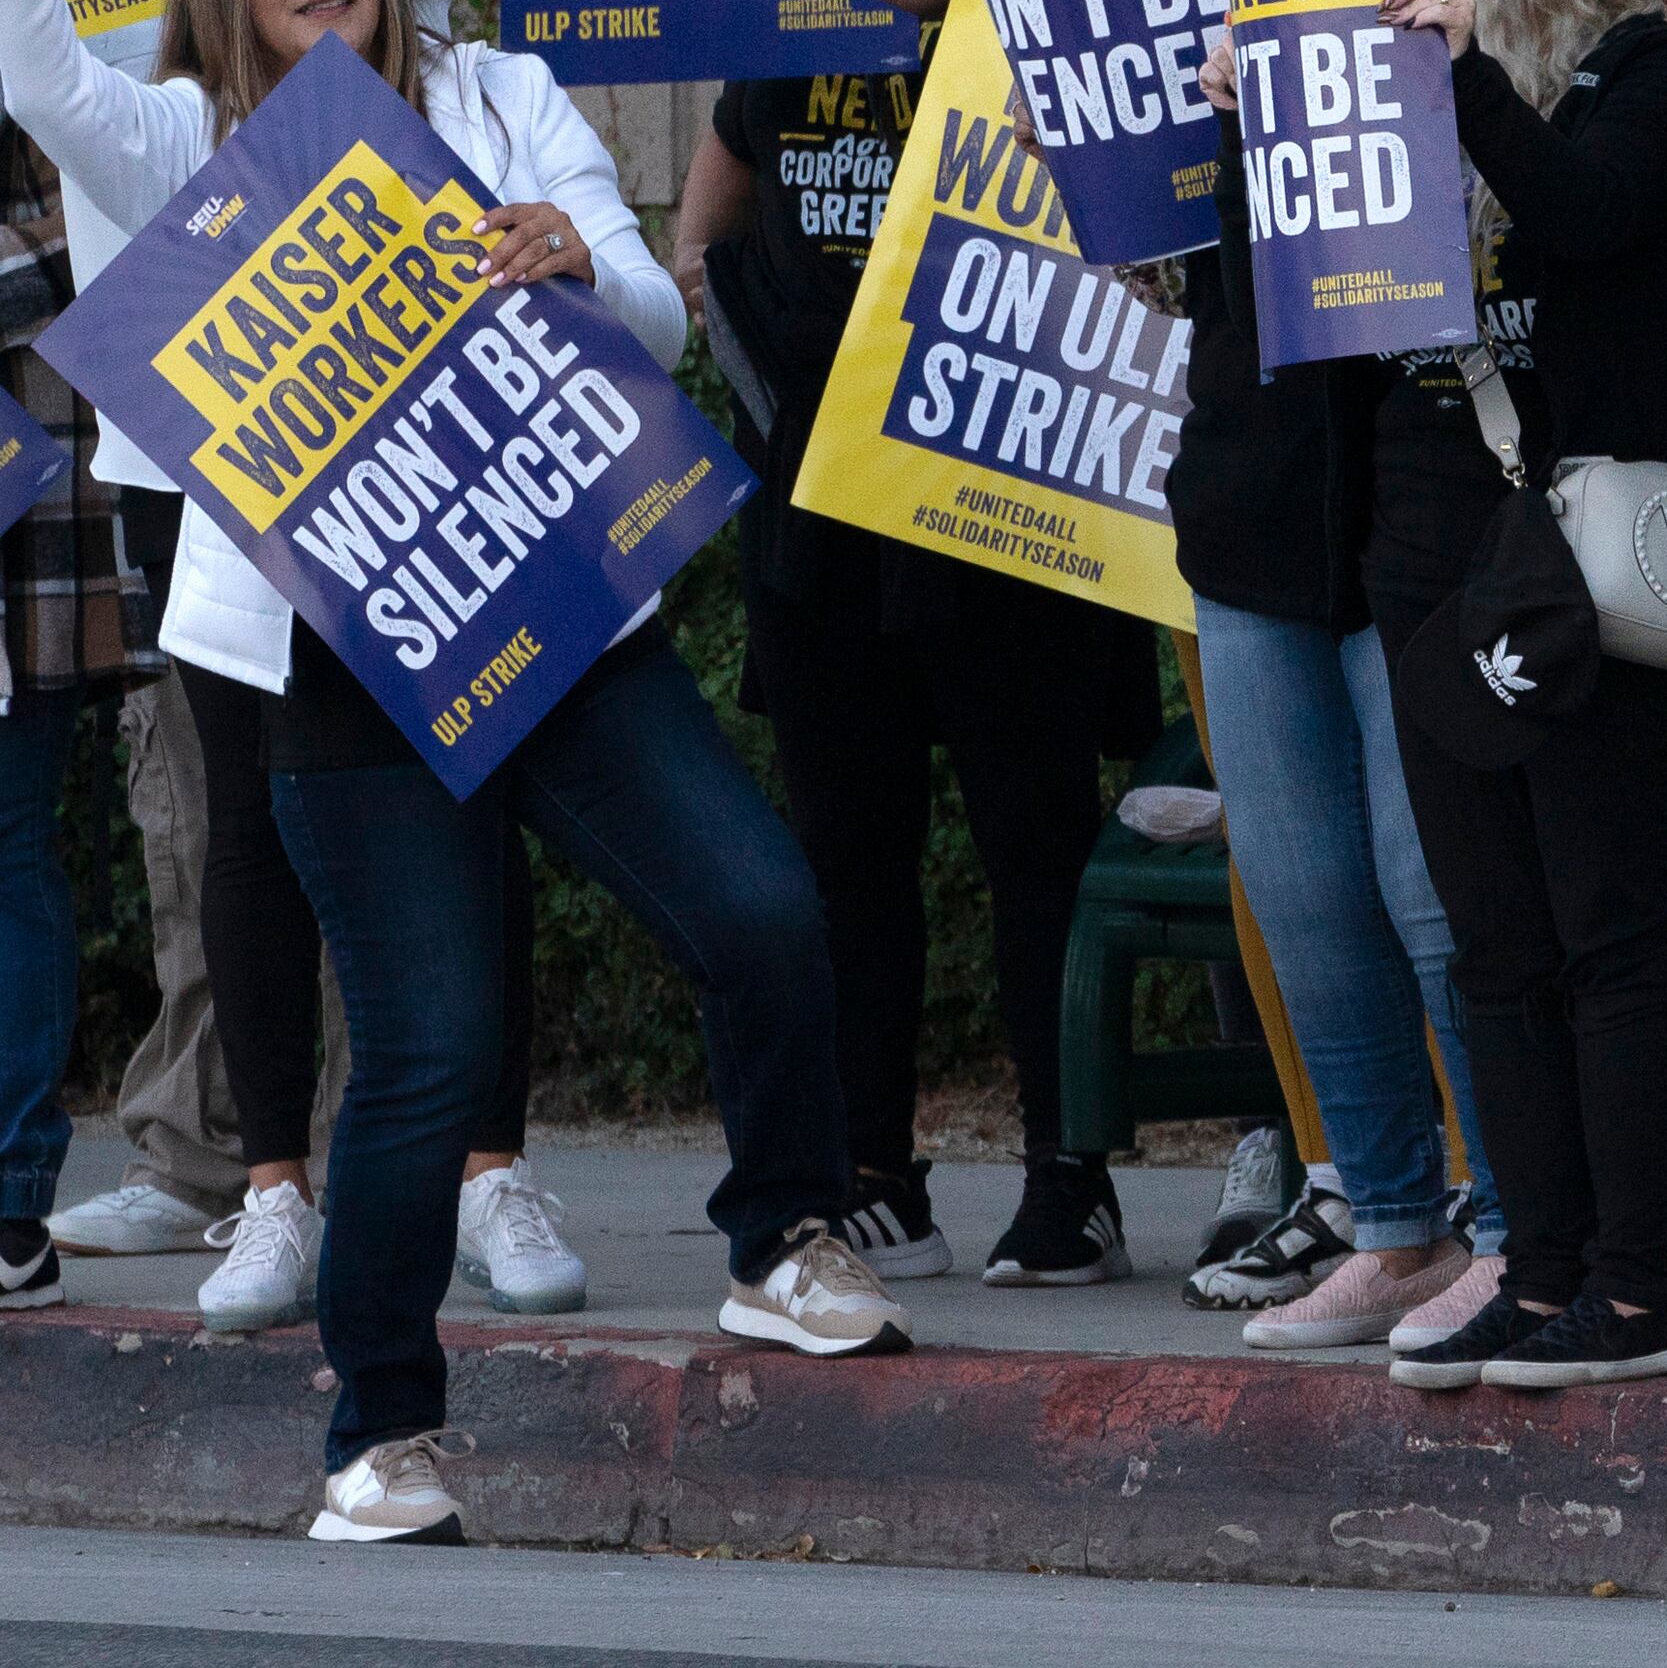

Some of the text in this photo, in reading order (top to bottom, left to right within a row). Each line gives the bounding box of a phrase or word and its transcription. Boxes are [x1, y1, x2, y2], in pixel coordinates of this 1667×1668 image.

[526, 6, 660, 41] ULP STRIKE
[779, 11, 893, 31] #SOLIDARITYSEASON
[807, 74, 913, 130] NED
[1018, 24, 1230, 147] ENCE
[1305, 28, 1402, 124] BE
[780, 150, 893, 188] CORPOR
[1171, 160, 1220, 186] #UNITE
[1243, 132, 1413, 241] NCED
[187, 194, 224, 237] SEIU-
[206, 193, 246, 239] UHW
[801, 191, 888, 239] GREE
[185, 176, 401, 404] KAISER
[940, 237, 1056, 353] ON
[1311, 270, 1395, 292] #UNITED4ALL
[1313, 281, 1444, 309] #SOLIDARITYSEASON
[215, 211, 487, 499] WORKERS
[293, 289, 578, 592] WON'T BE
[908, 341, 1186, 511] STRIKE
[366, 368, 642, 670] SILENCED
[607, 478, 670, 543] #UNITED4ALL
[617, 457, 713, 556] #SOLIDARITYSEASON
[955, 486, 1077, 544] #UNITED4ALL
[912, 504, 1105, 583] #SOLIDARITYSEASON
[432, 627, 543, 747] ULP STRIKE
[1473, 650, 1517, 706] adidas
